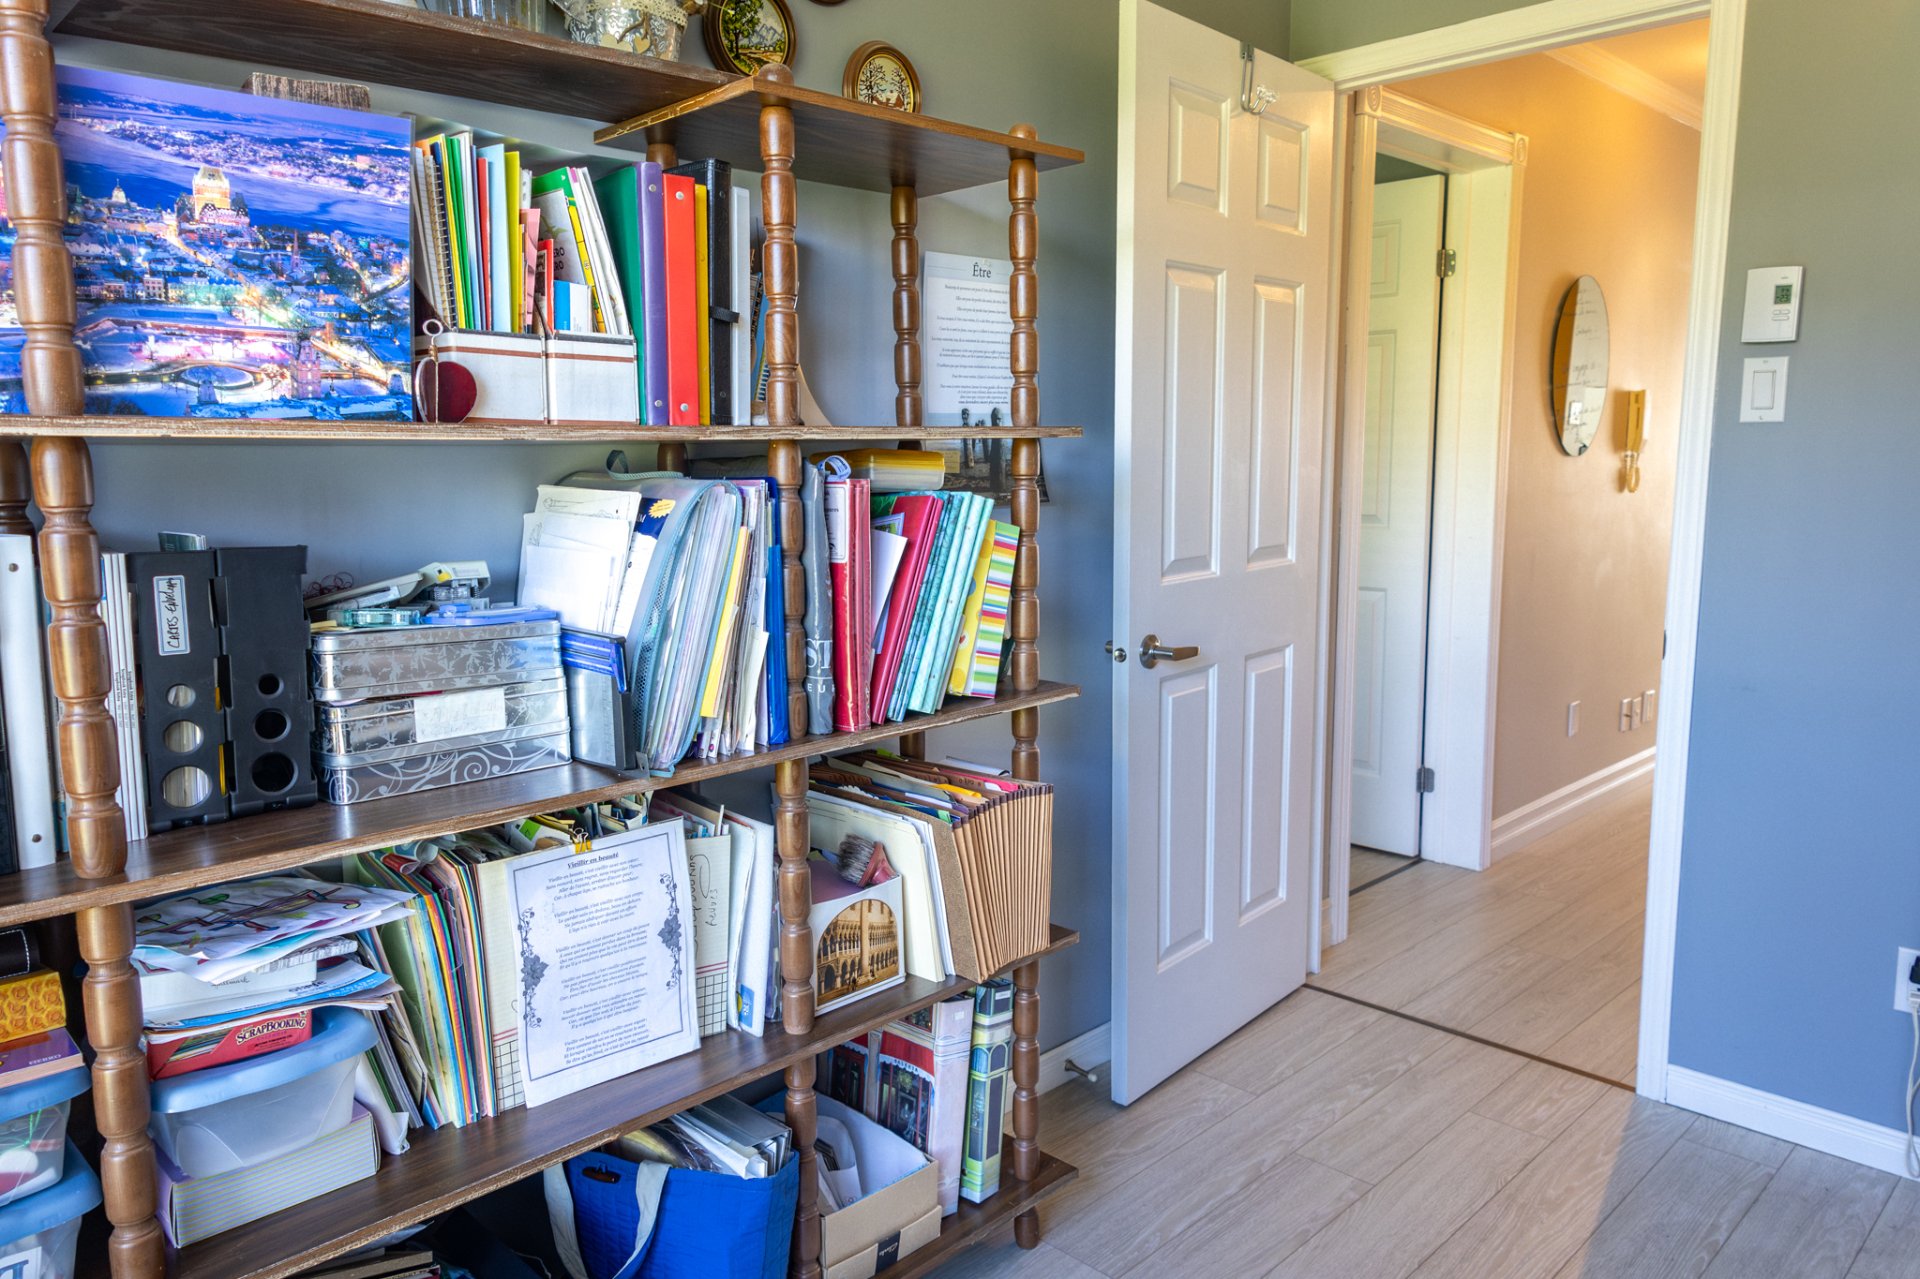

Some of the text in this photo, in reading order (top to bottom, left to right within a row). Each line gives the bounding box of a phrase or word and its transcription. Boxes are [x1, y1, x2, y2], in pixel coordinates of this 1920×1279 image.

[972, 262, 992, 278] Être
[567, 859, 588, 868] Vieillir
[598, 852, 618, 860] beauté
